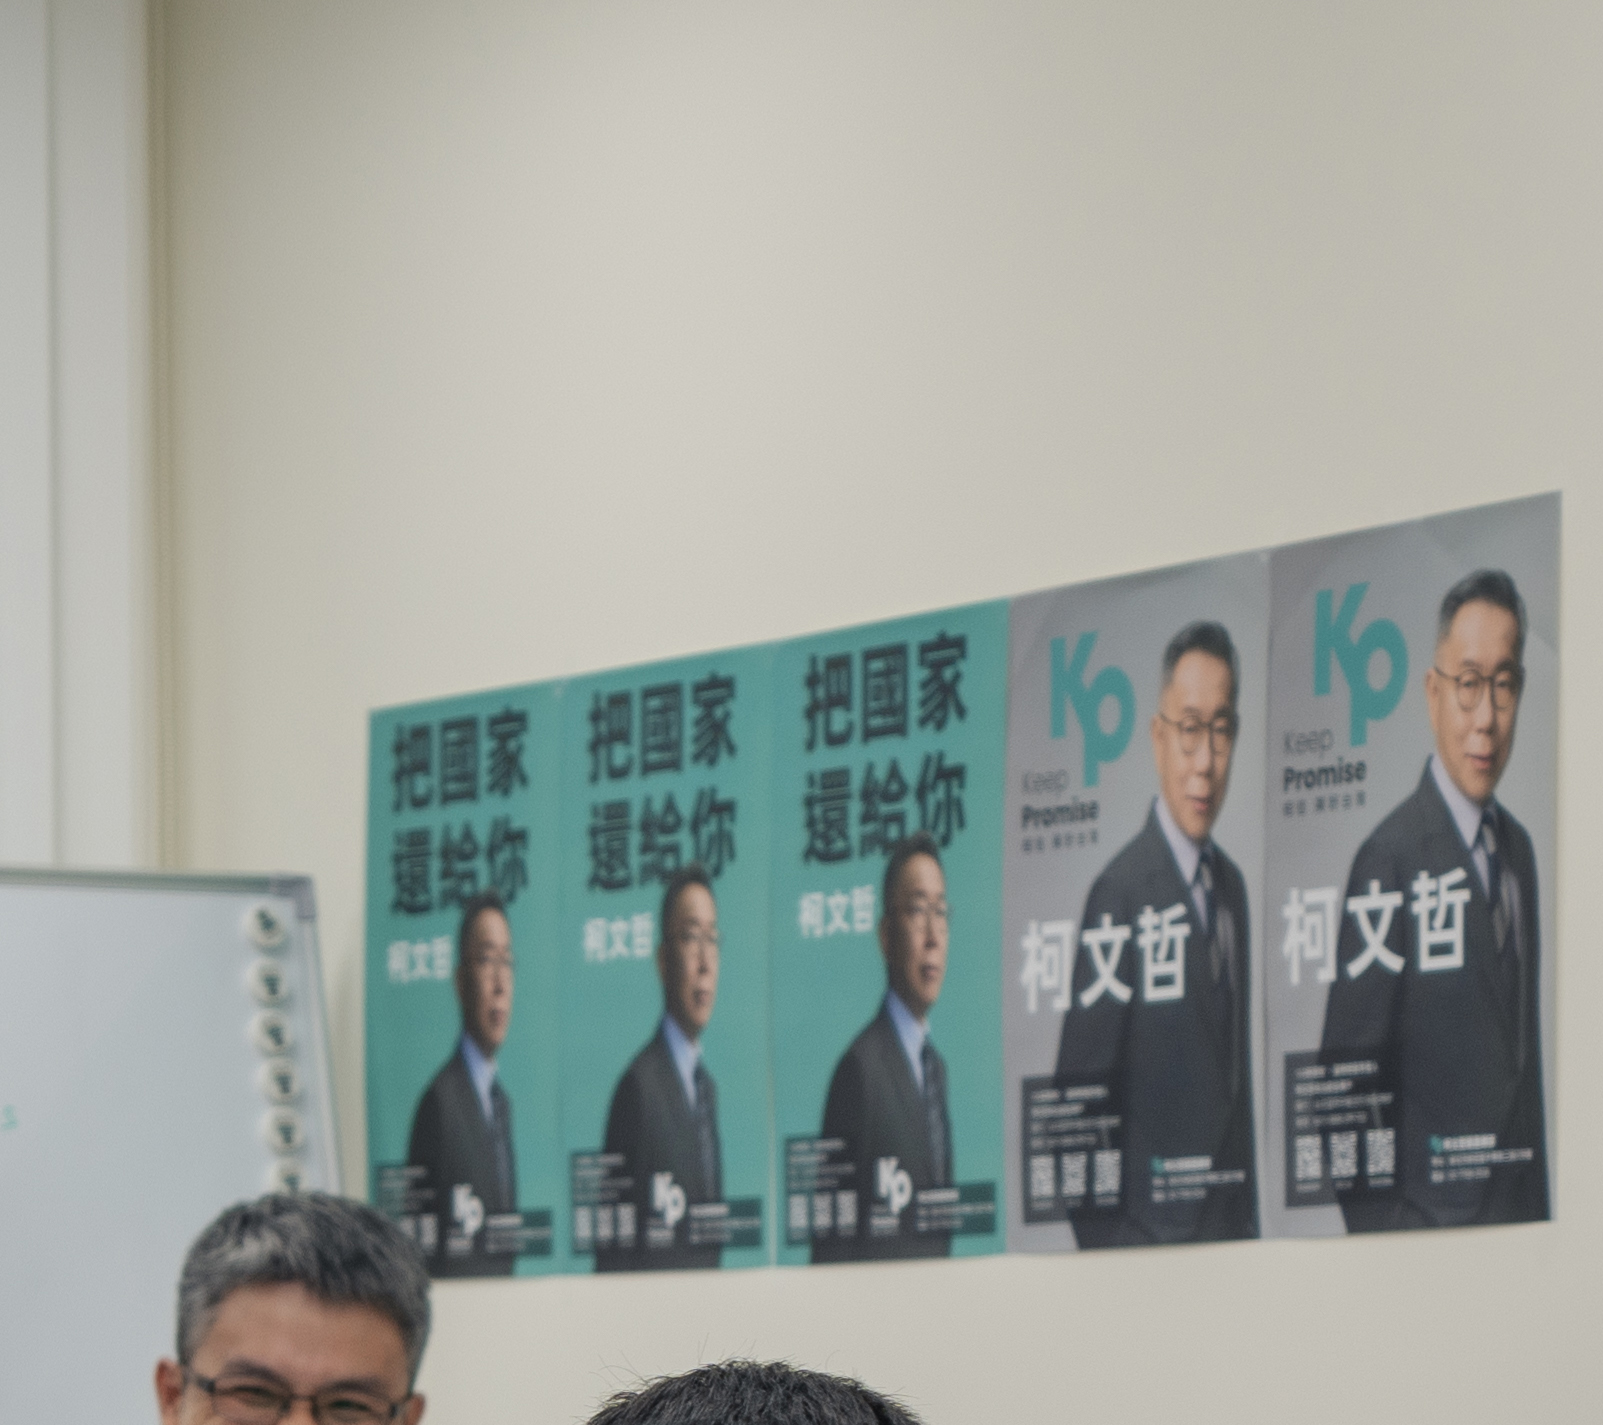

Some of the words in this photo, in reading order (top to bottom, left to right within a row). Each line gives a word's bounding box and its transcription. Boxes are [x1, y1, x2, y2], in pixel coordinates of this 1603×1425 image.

[587, 671, 736, 785] 把國家
[804, 630, 968, 751] 把國家
[1282, 726, 1335, 760] Keep
[391, 706, 529, 812] 把國家
[803, 751, 967, 865] 還給你
[1282, 756, 1368, 792] Promise
[391, 815, 529, 916] 還給你
[588, 787, 736, 892] 還給你
[1021, 796, 1099, 830] Promise
[1020, 903, 1191, 1014] 柯文哲
[1282, 867, 1472, 986] 柯文哲
